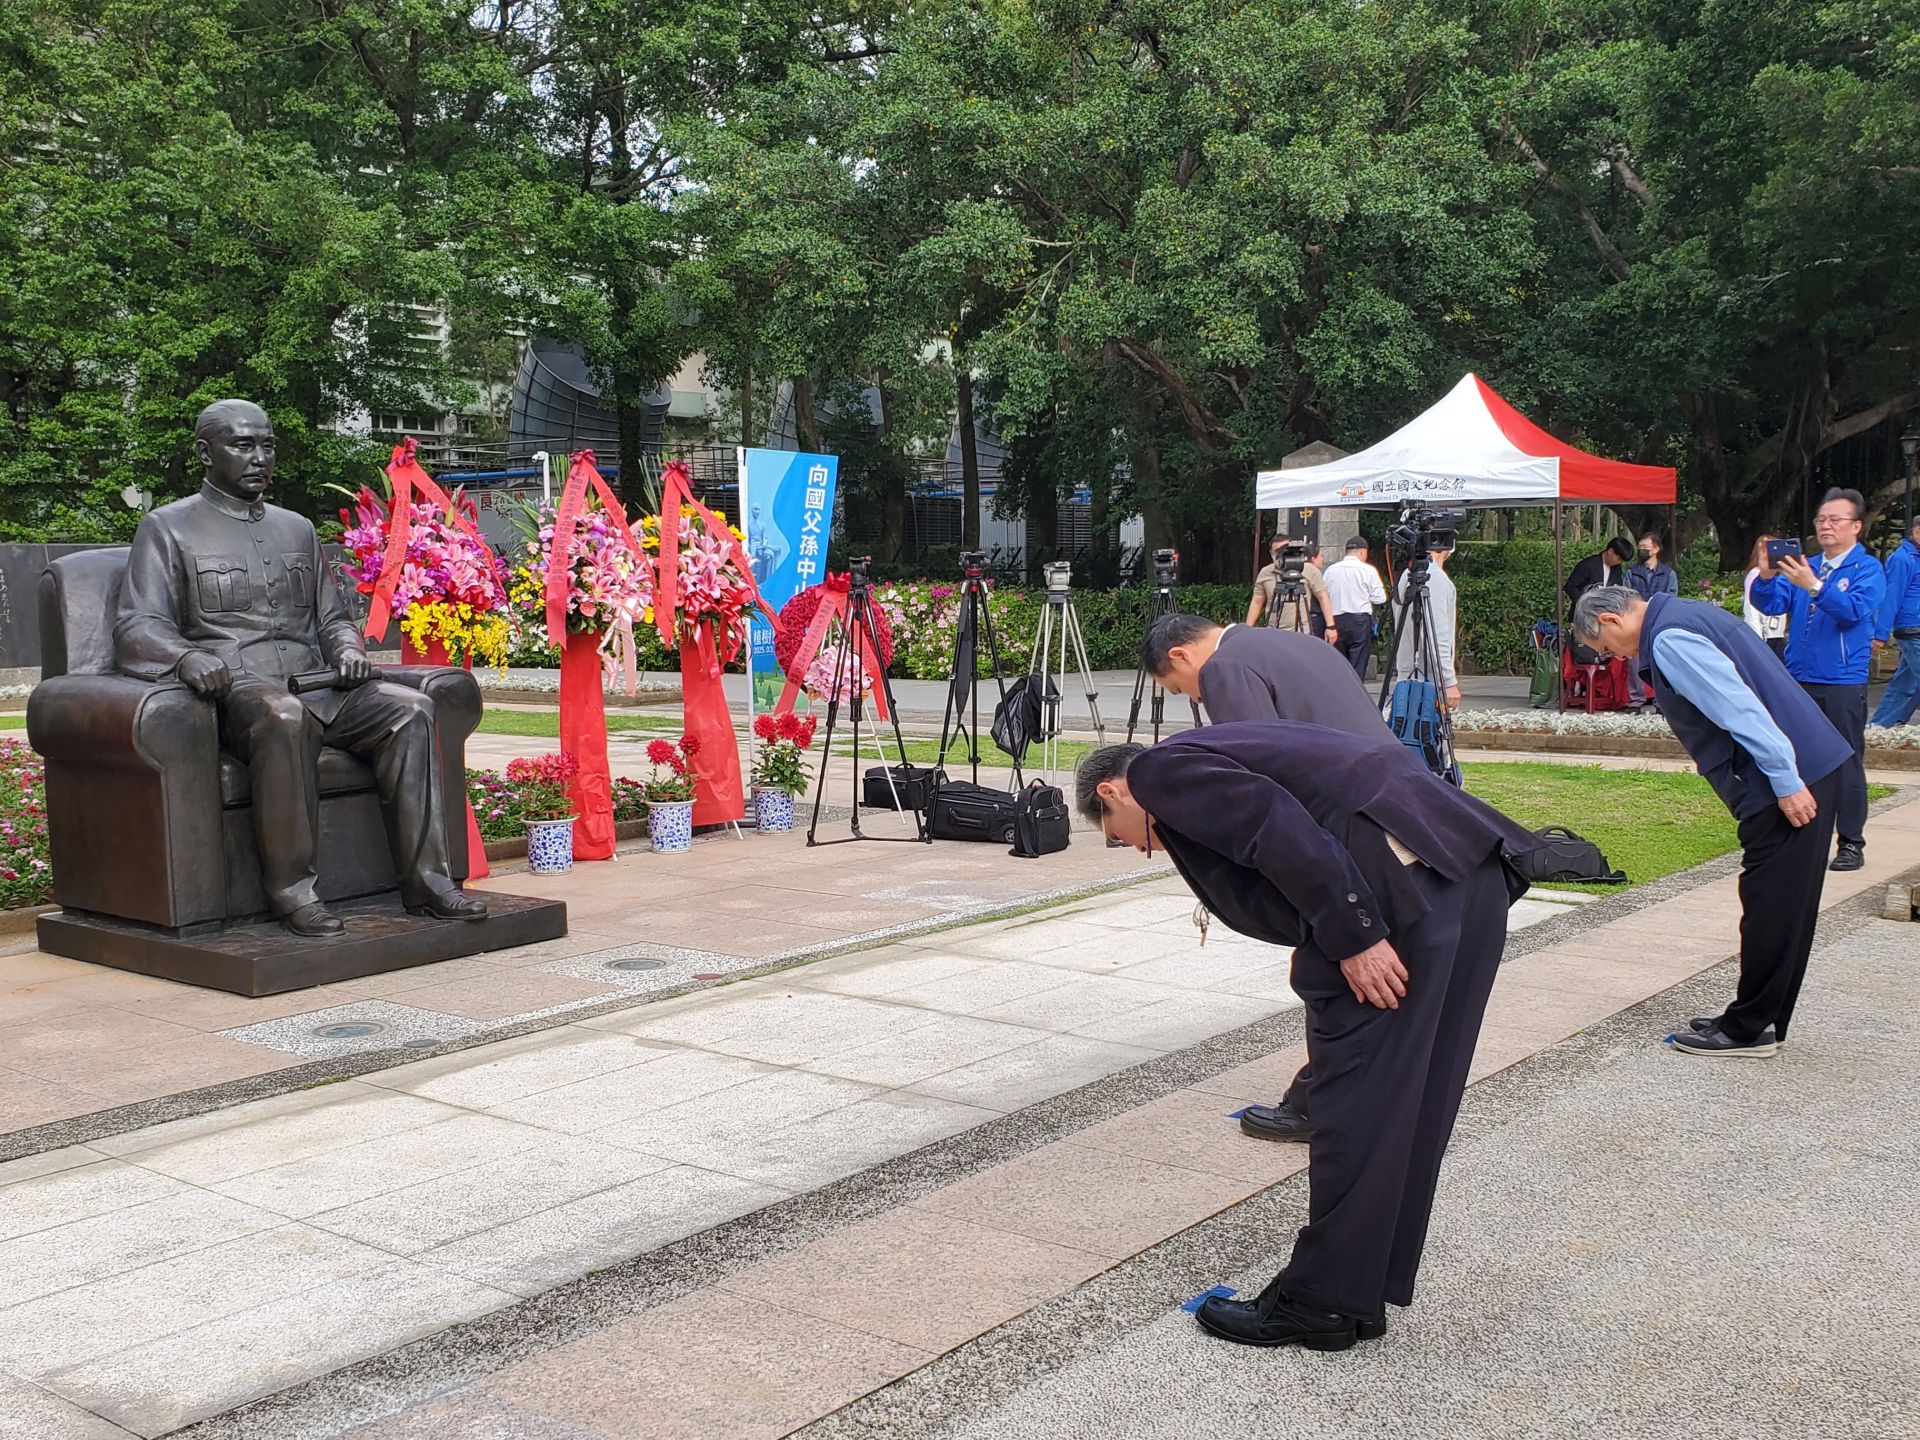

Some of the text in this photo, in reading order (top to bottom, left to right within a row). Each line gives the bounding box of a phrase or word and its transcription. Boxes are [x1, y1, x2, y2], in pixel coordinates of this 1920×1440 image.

[1373, 477, 1466, 493] 國立國父紀念館
[753, 629, 775, 645] 植樹
[753, 645, 774, 655] 2025.03
